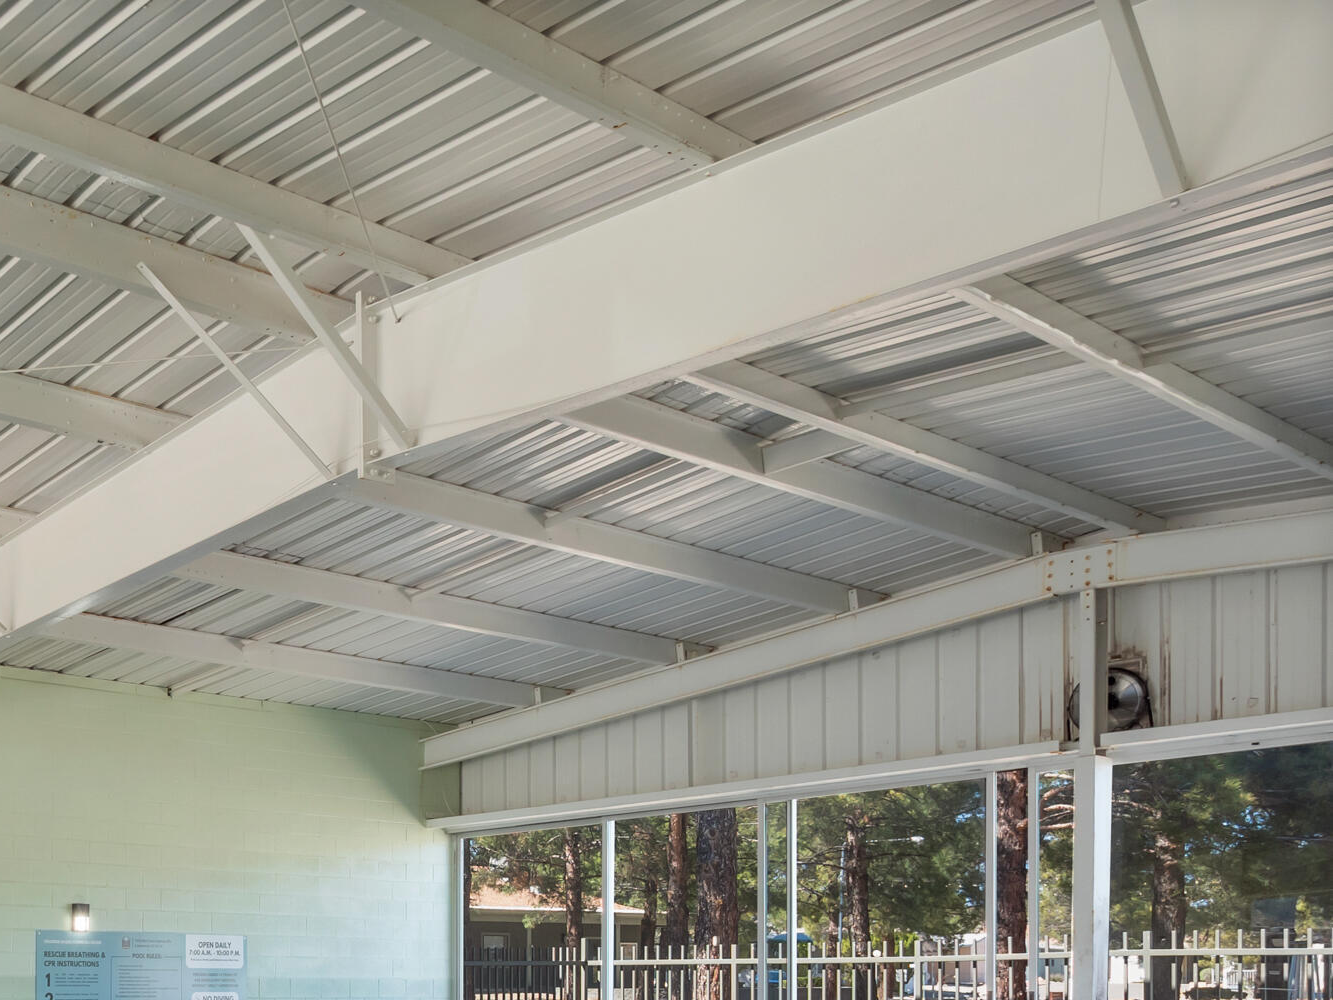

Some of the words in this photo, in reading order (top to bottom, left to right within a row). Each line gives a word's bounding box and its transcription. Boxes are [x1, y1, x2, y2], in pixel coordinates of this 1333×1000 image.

[198, 941, 214, 949] OPEN
[215, 941, 231, 949] DAILY
[67, 951, 100, 959] BREATHING
[45, 972, 51, 987] 1
